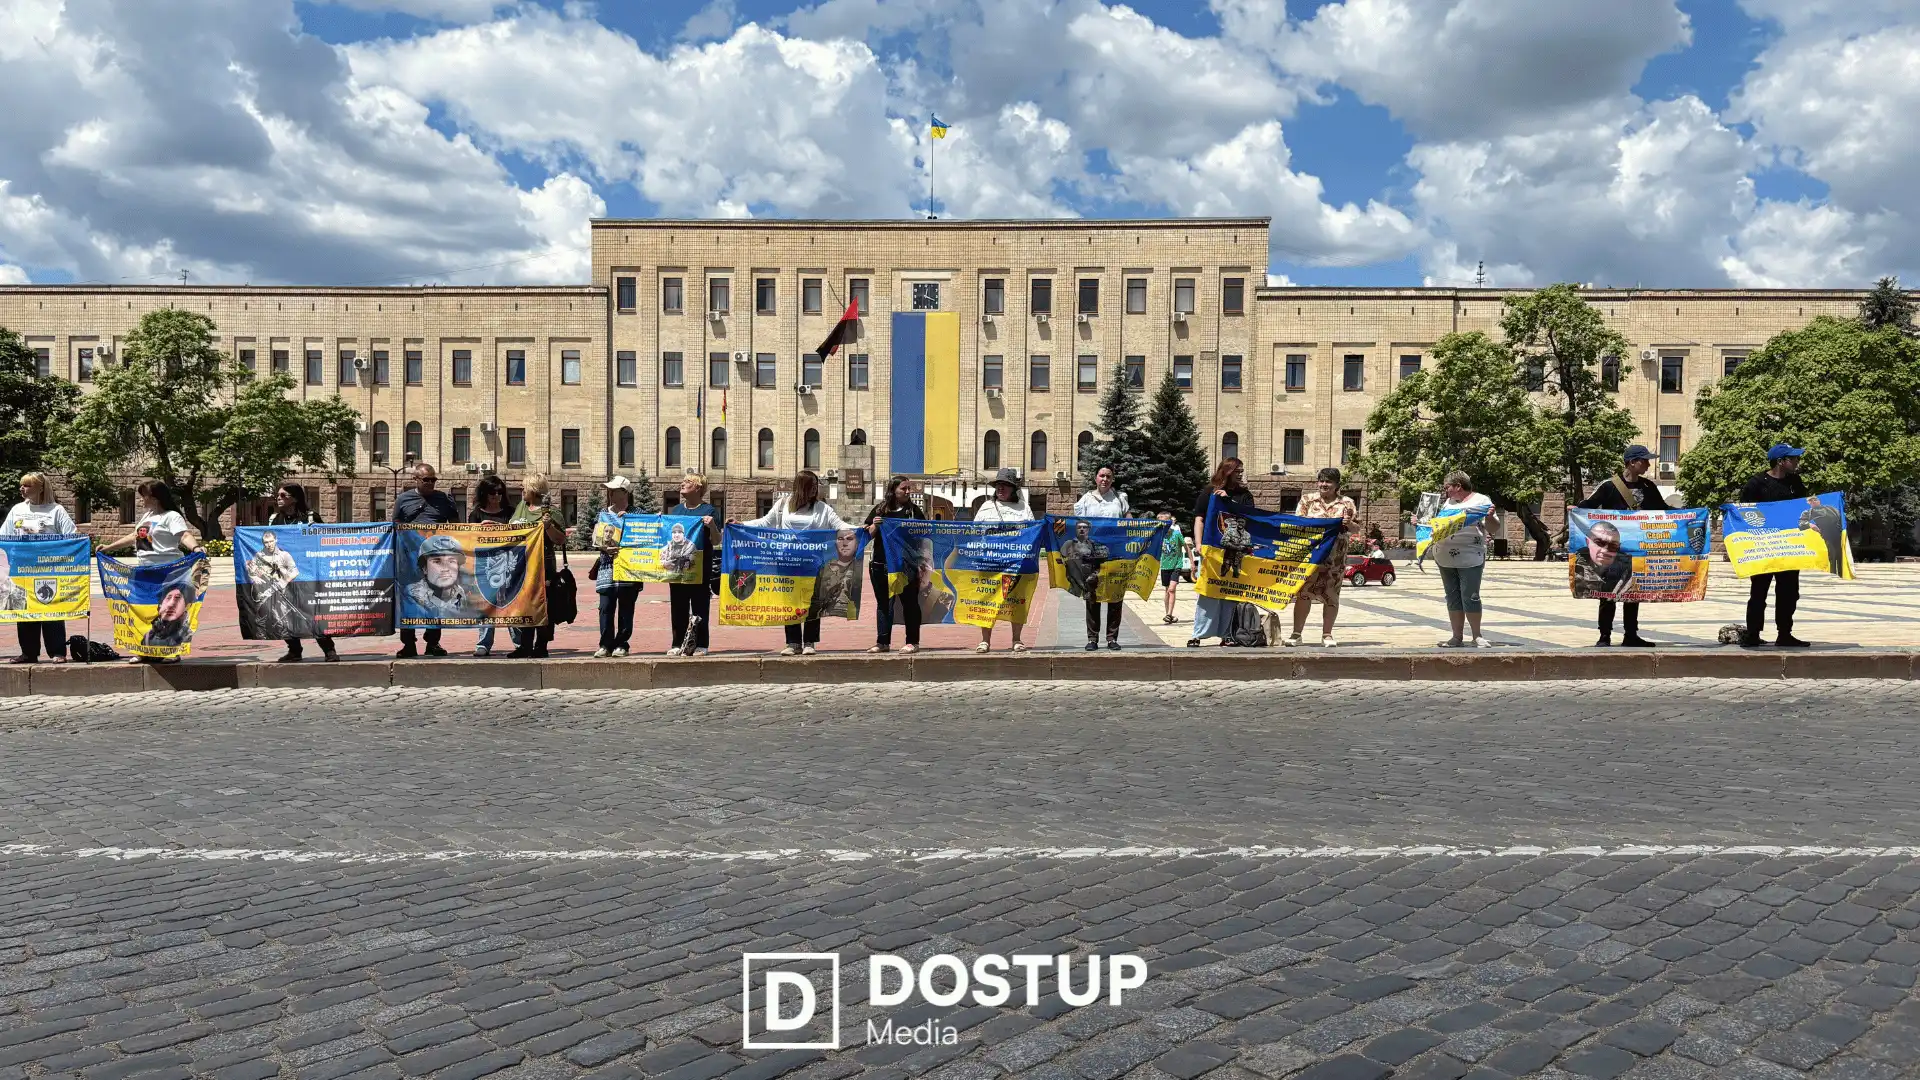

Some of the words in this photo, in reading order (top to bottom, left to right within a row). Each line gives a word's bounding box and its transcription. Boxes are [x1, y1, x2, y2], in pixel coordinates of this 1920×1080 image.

[757, 531, 797, 540] ШТОНДА
[731, 540, 767, 549] ДМИТРО
[770, 541, 828, 550] СЕРГІЙОВИЧ
[966, 542, 1032, 550] МІРОШНІЧЕНКО
[958, 549, 984, 557] Сергій
